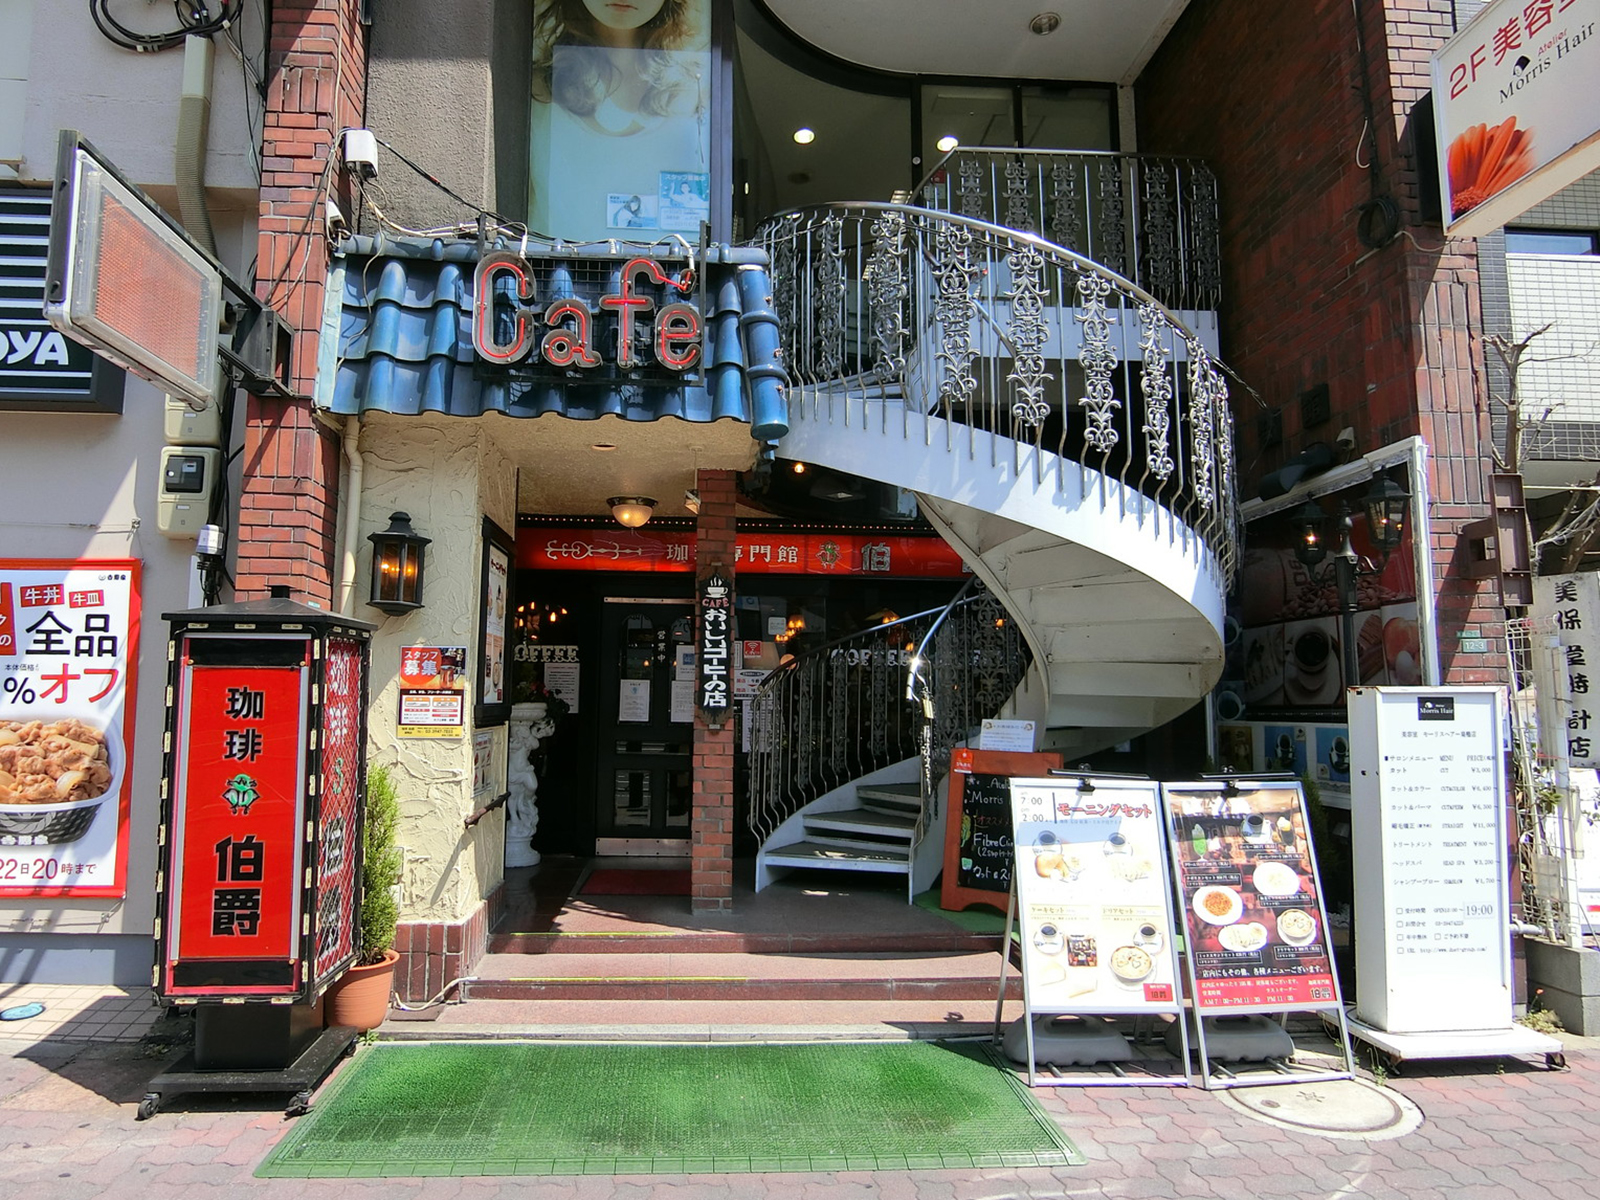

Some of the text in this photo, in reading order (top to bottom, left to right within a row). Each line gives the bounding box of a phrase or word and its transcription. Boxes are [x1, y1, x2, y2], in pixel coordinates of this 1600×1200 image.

[1449, 0, 1577, 100] 2F美容
[1538, 28, 1567, 56] Atelier
[1500, 22, 1594, 104] Morris Hair
[0, 331, 69, 365] YA
[666, 543, 799, 563] 珈門館
[24, 586, 61, 605] 牛丼
[72, 592, 100, 606] 牛皿
[25, 610, 118, 657] 全品
[405, 651, 438, 660] スタッフ
[1465, 642, 1484, 650] 12-3
[704, 608, 727, 707] おいしいコーヒーの店
[830, 649, 910, 666] COFEE
[404, 660, 438, 676] 募集
[970, 791, 1003, 805] Morris
[211, 686, 265, 938] 珈琲 伯爵
[1058, 802, 1153, 819] モーニングセット
[1466, 904, 1493, 916] 19:00
